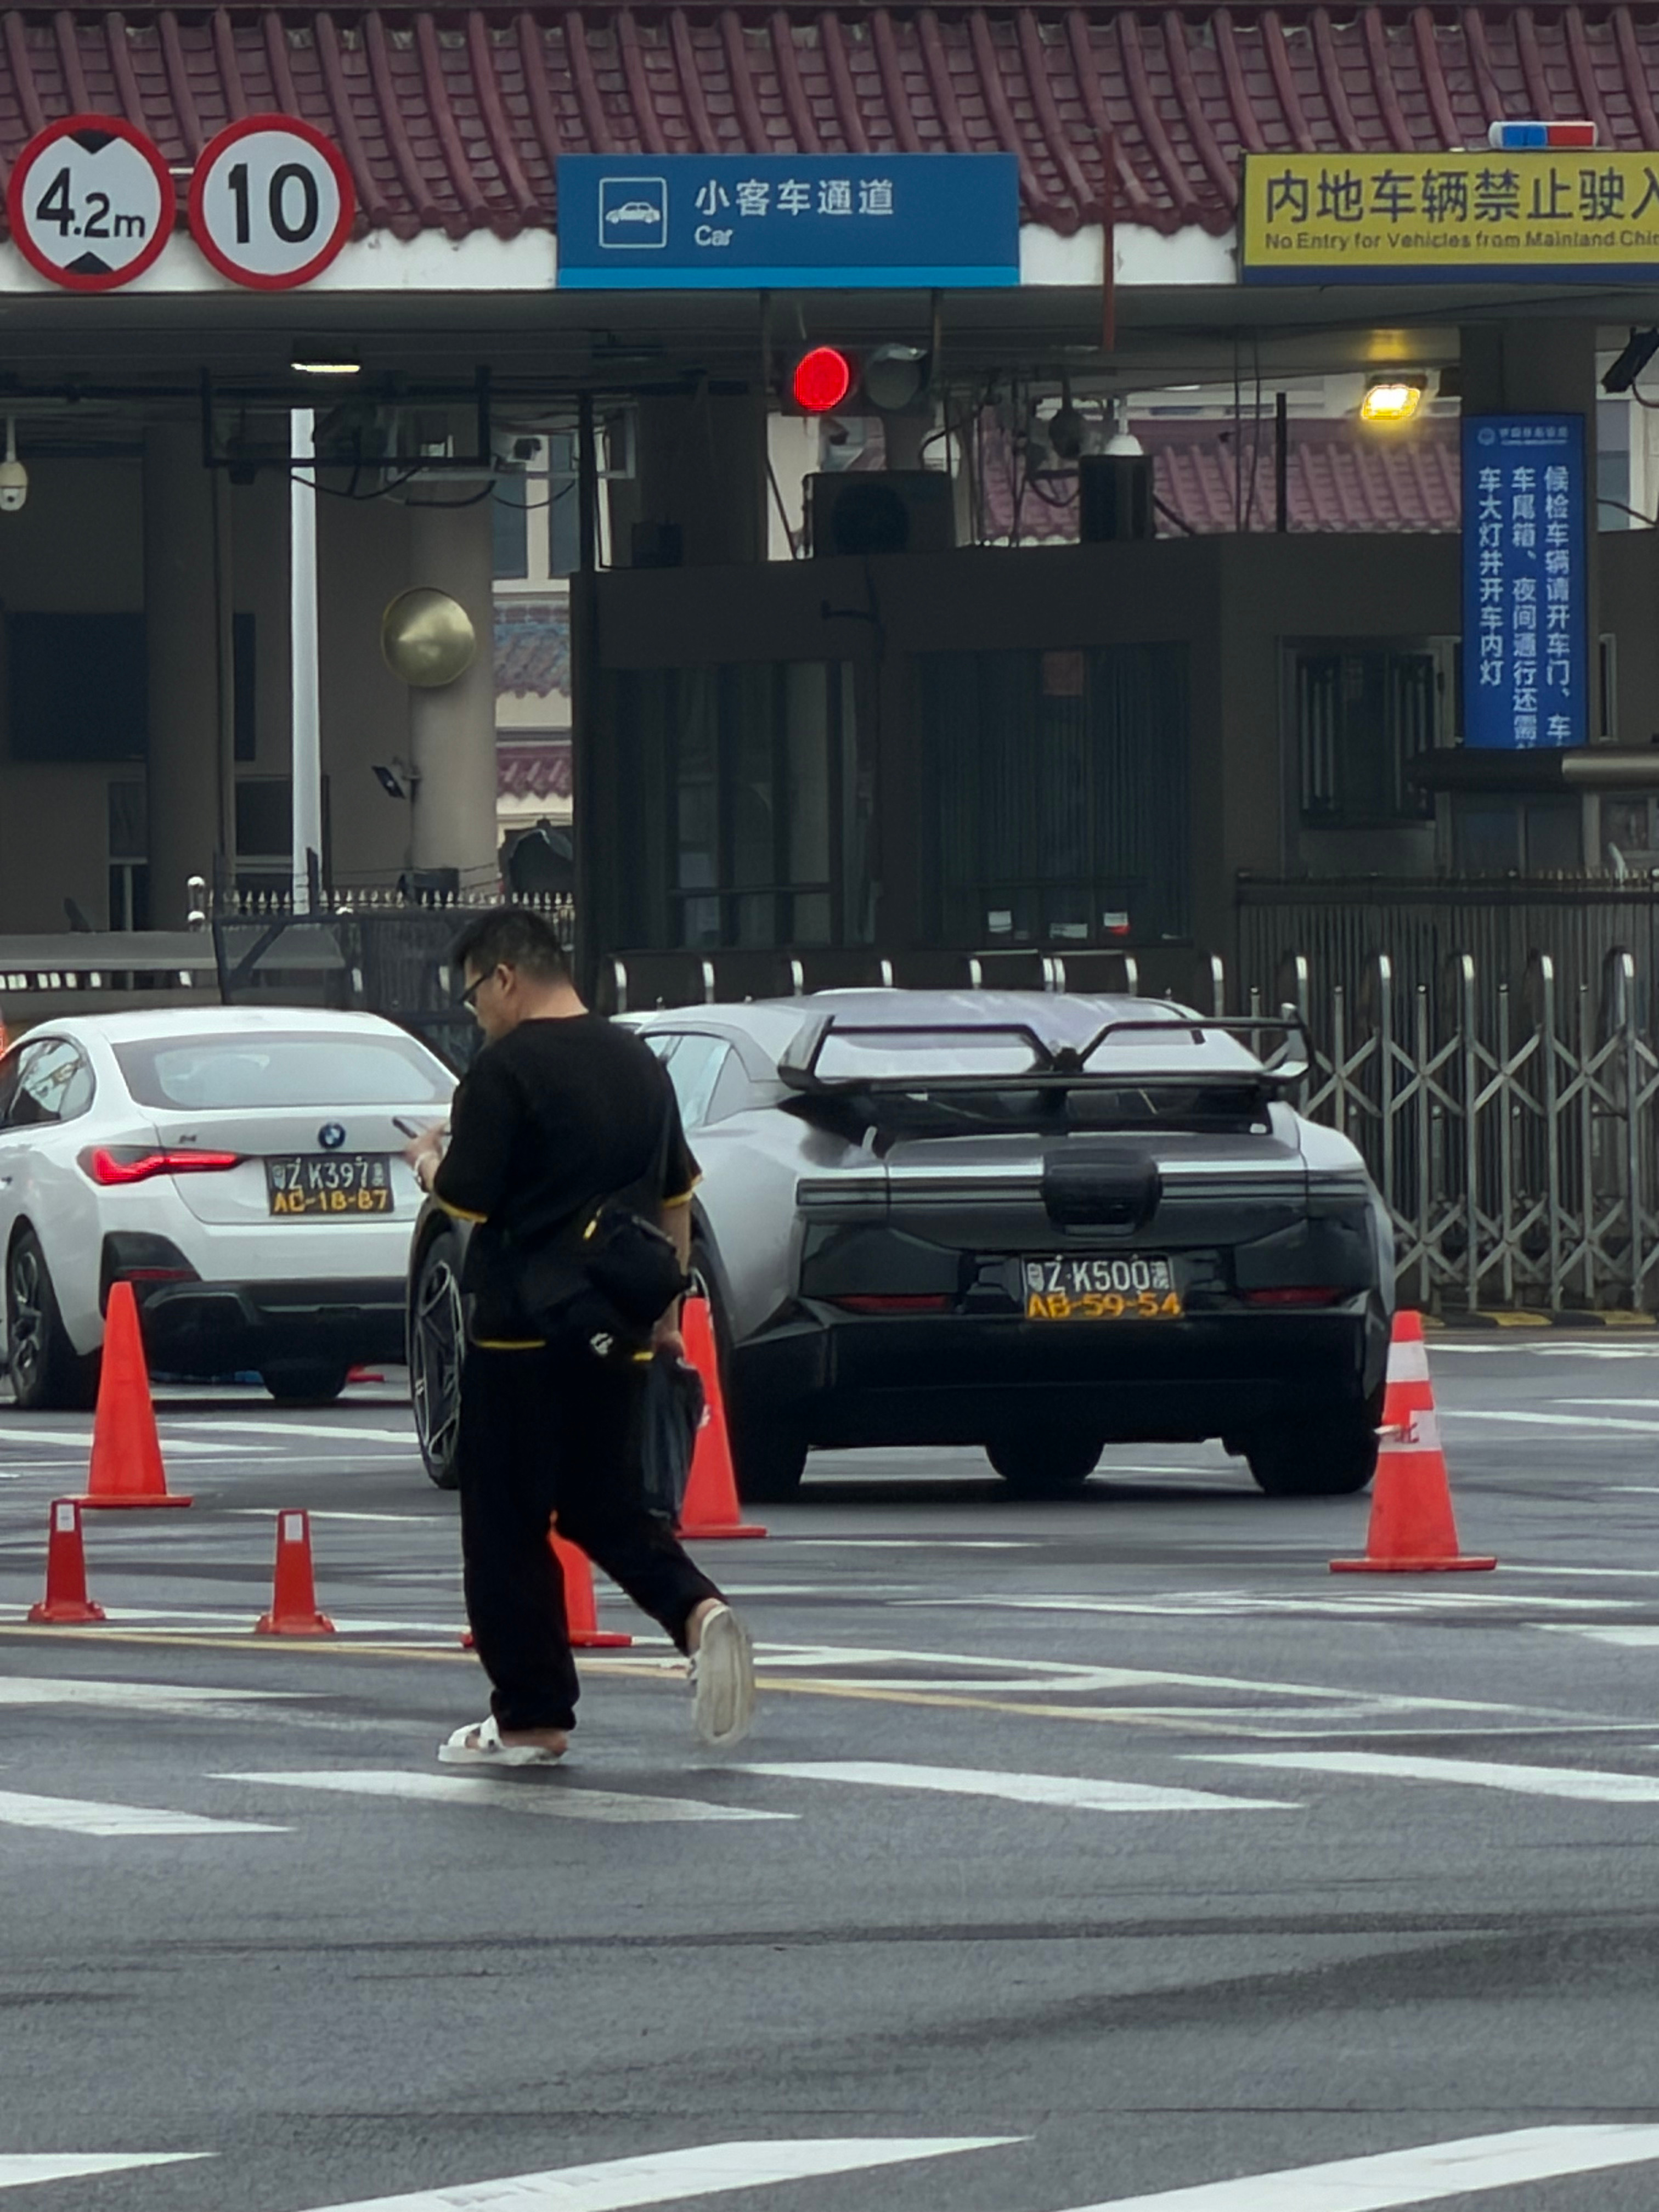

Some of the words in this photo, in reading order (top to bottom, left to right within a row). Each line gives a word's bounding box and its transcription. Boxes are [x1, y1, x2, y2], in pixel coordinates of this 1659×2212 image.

[36, 167, 146, 238] 4.2m
[228, 162, 319, 244] 10
[695, 178, 894, 217] 小客车通道
[1267, 167, 1659, 223] 内地车辆禁止驶入
[694, 225, 733, 246] Car
[1265, 233, 1293, 249] No
[1297, 232, 1350, 251] Entry
[1354, 233, 1381, 249] for
[1387, 232, 1471, 248] Vehicles
[1476, 231, 1520, 248] from
[1526, 230, 1615, 247] Mainland
[1478, 467, 1504, 686] 车大灯并开车内灯
[1511, 466, 1537, 749] 车尾箱、夜间通行还需
[1544, 465, 1571, 746] 候检车辆请开车门、车
